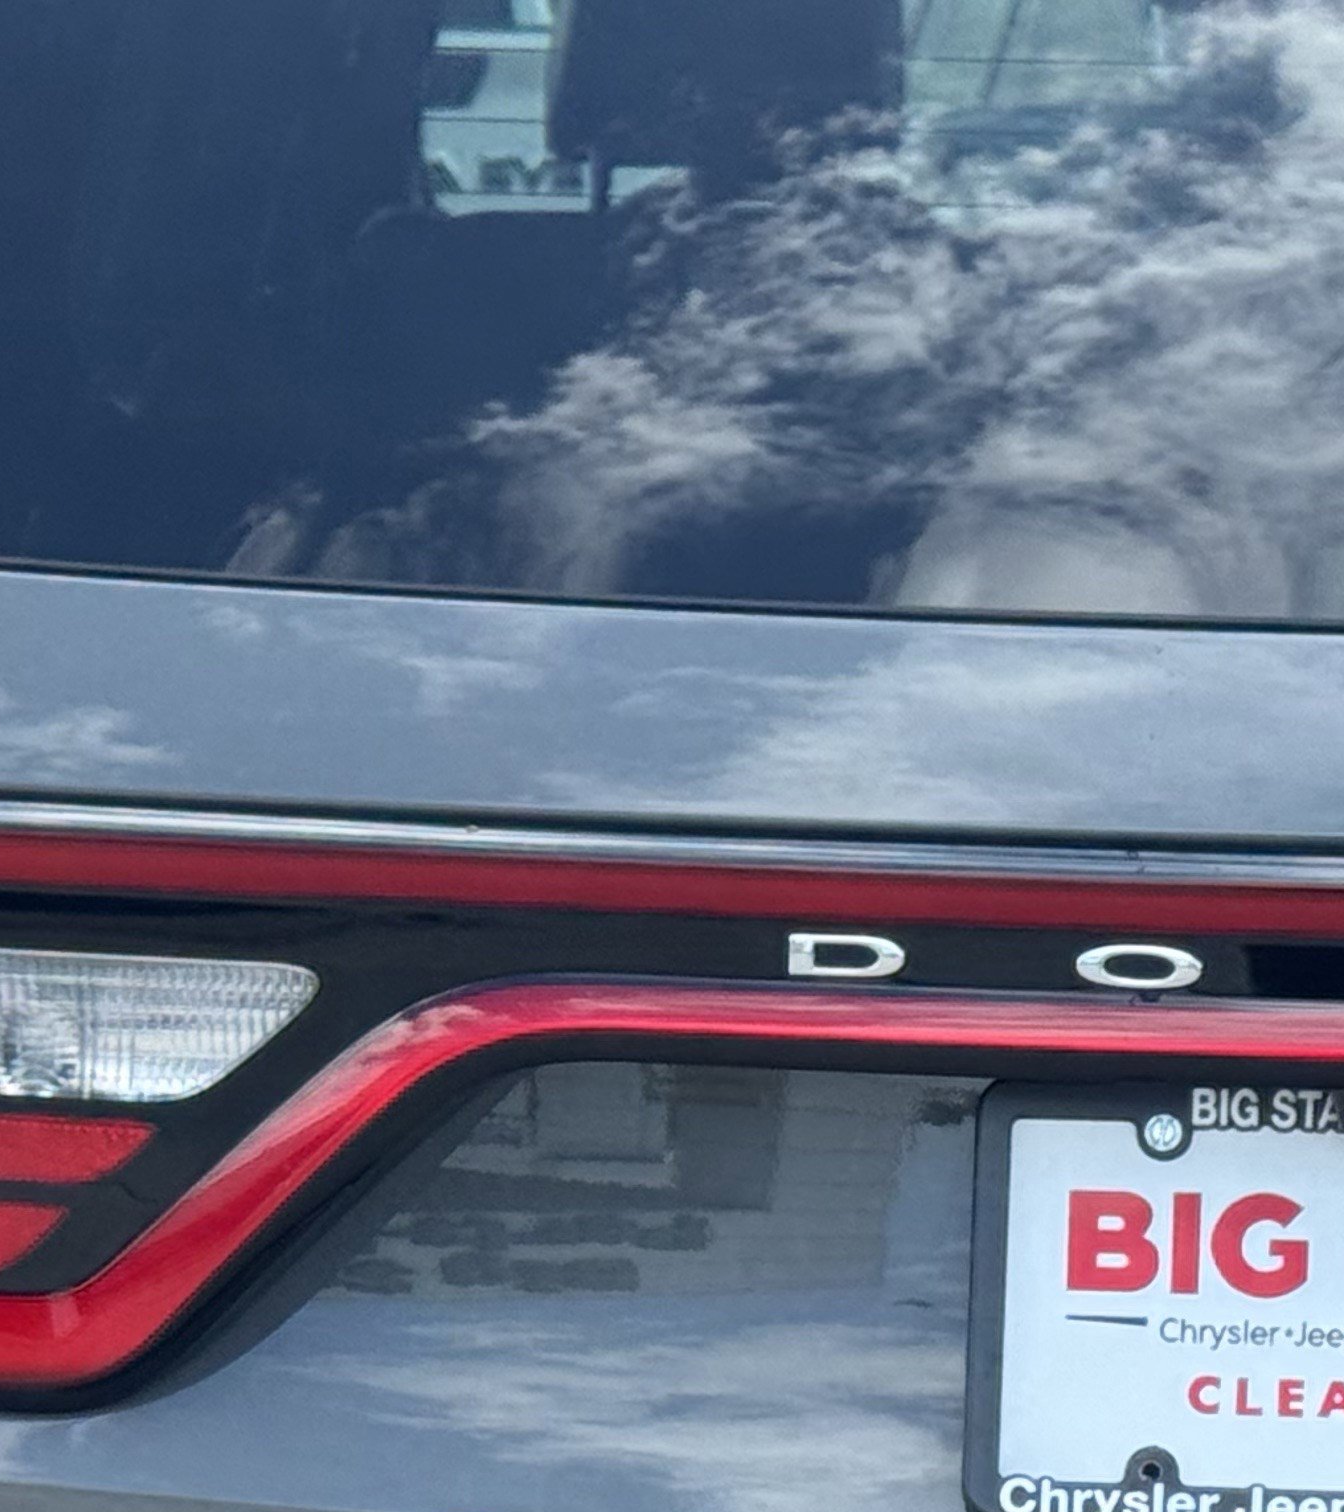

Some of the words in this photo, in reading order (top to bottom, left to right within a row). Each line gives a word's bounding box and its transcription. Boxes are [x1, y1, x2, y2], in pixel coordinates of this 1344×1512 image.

[1191, 1087, 1260, 1128] BIG
[1065, 1190, 1309, 1298] BIG
[1158, 1316, 1281, 1350] Chrysler
